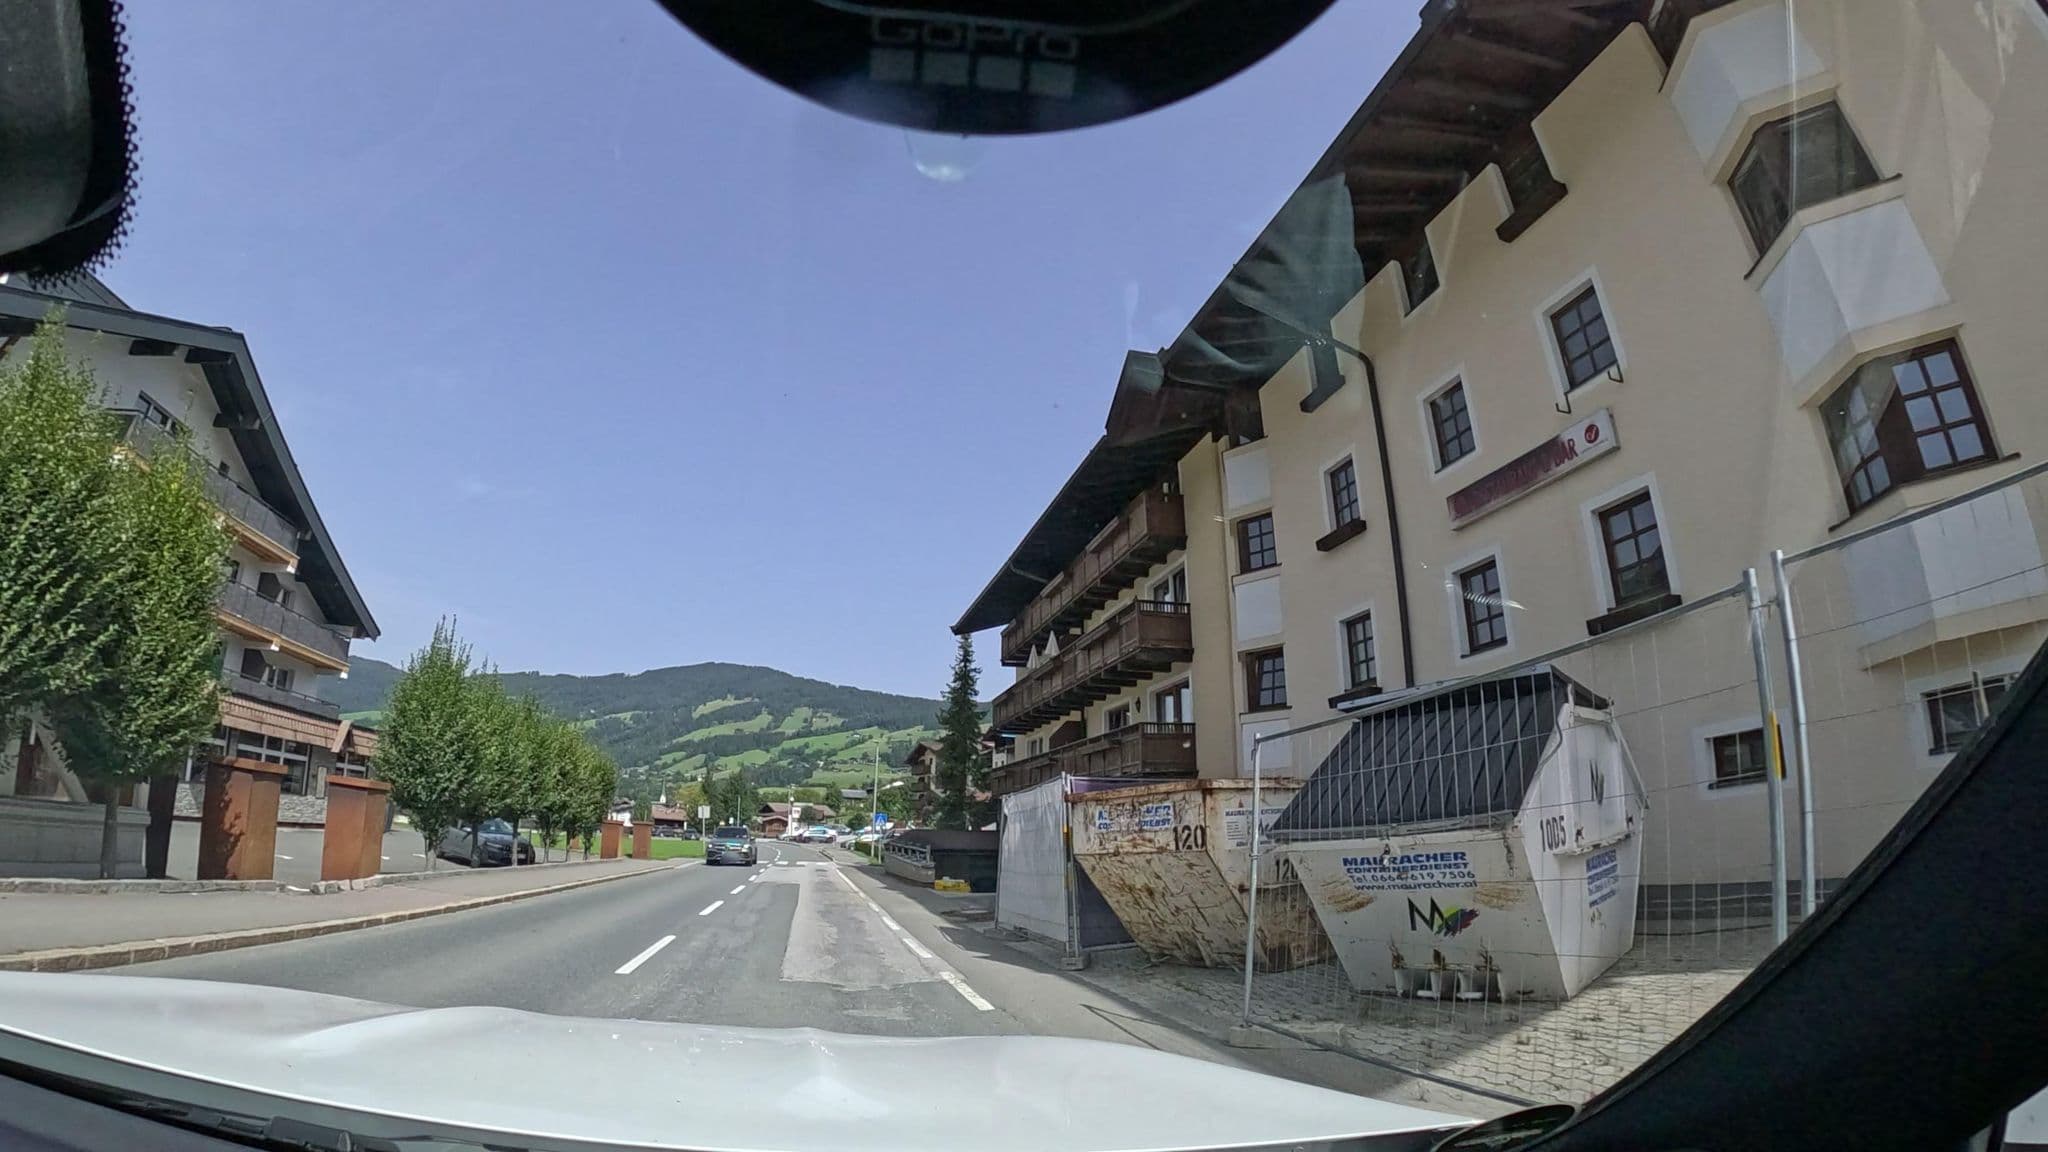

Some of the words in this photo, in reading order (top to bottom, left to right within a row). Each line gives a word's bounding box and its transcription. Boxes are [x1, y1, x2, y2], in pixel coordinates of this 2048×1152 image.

[1173, 824, 1206, 851] 120
[1342, 851, 1467, 867] MAURACHER
[1441, 870, 1475, 880] 7506
